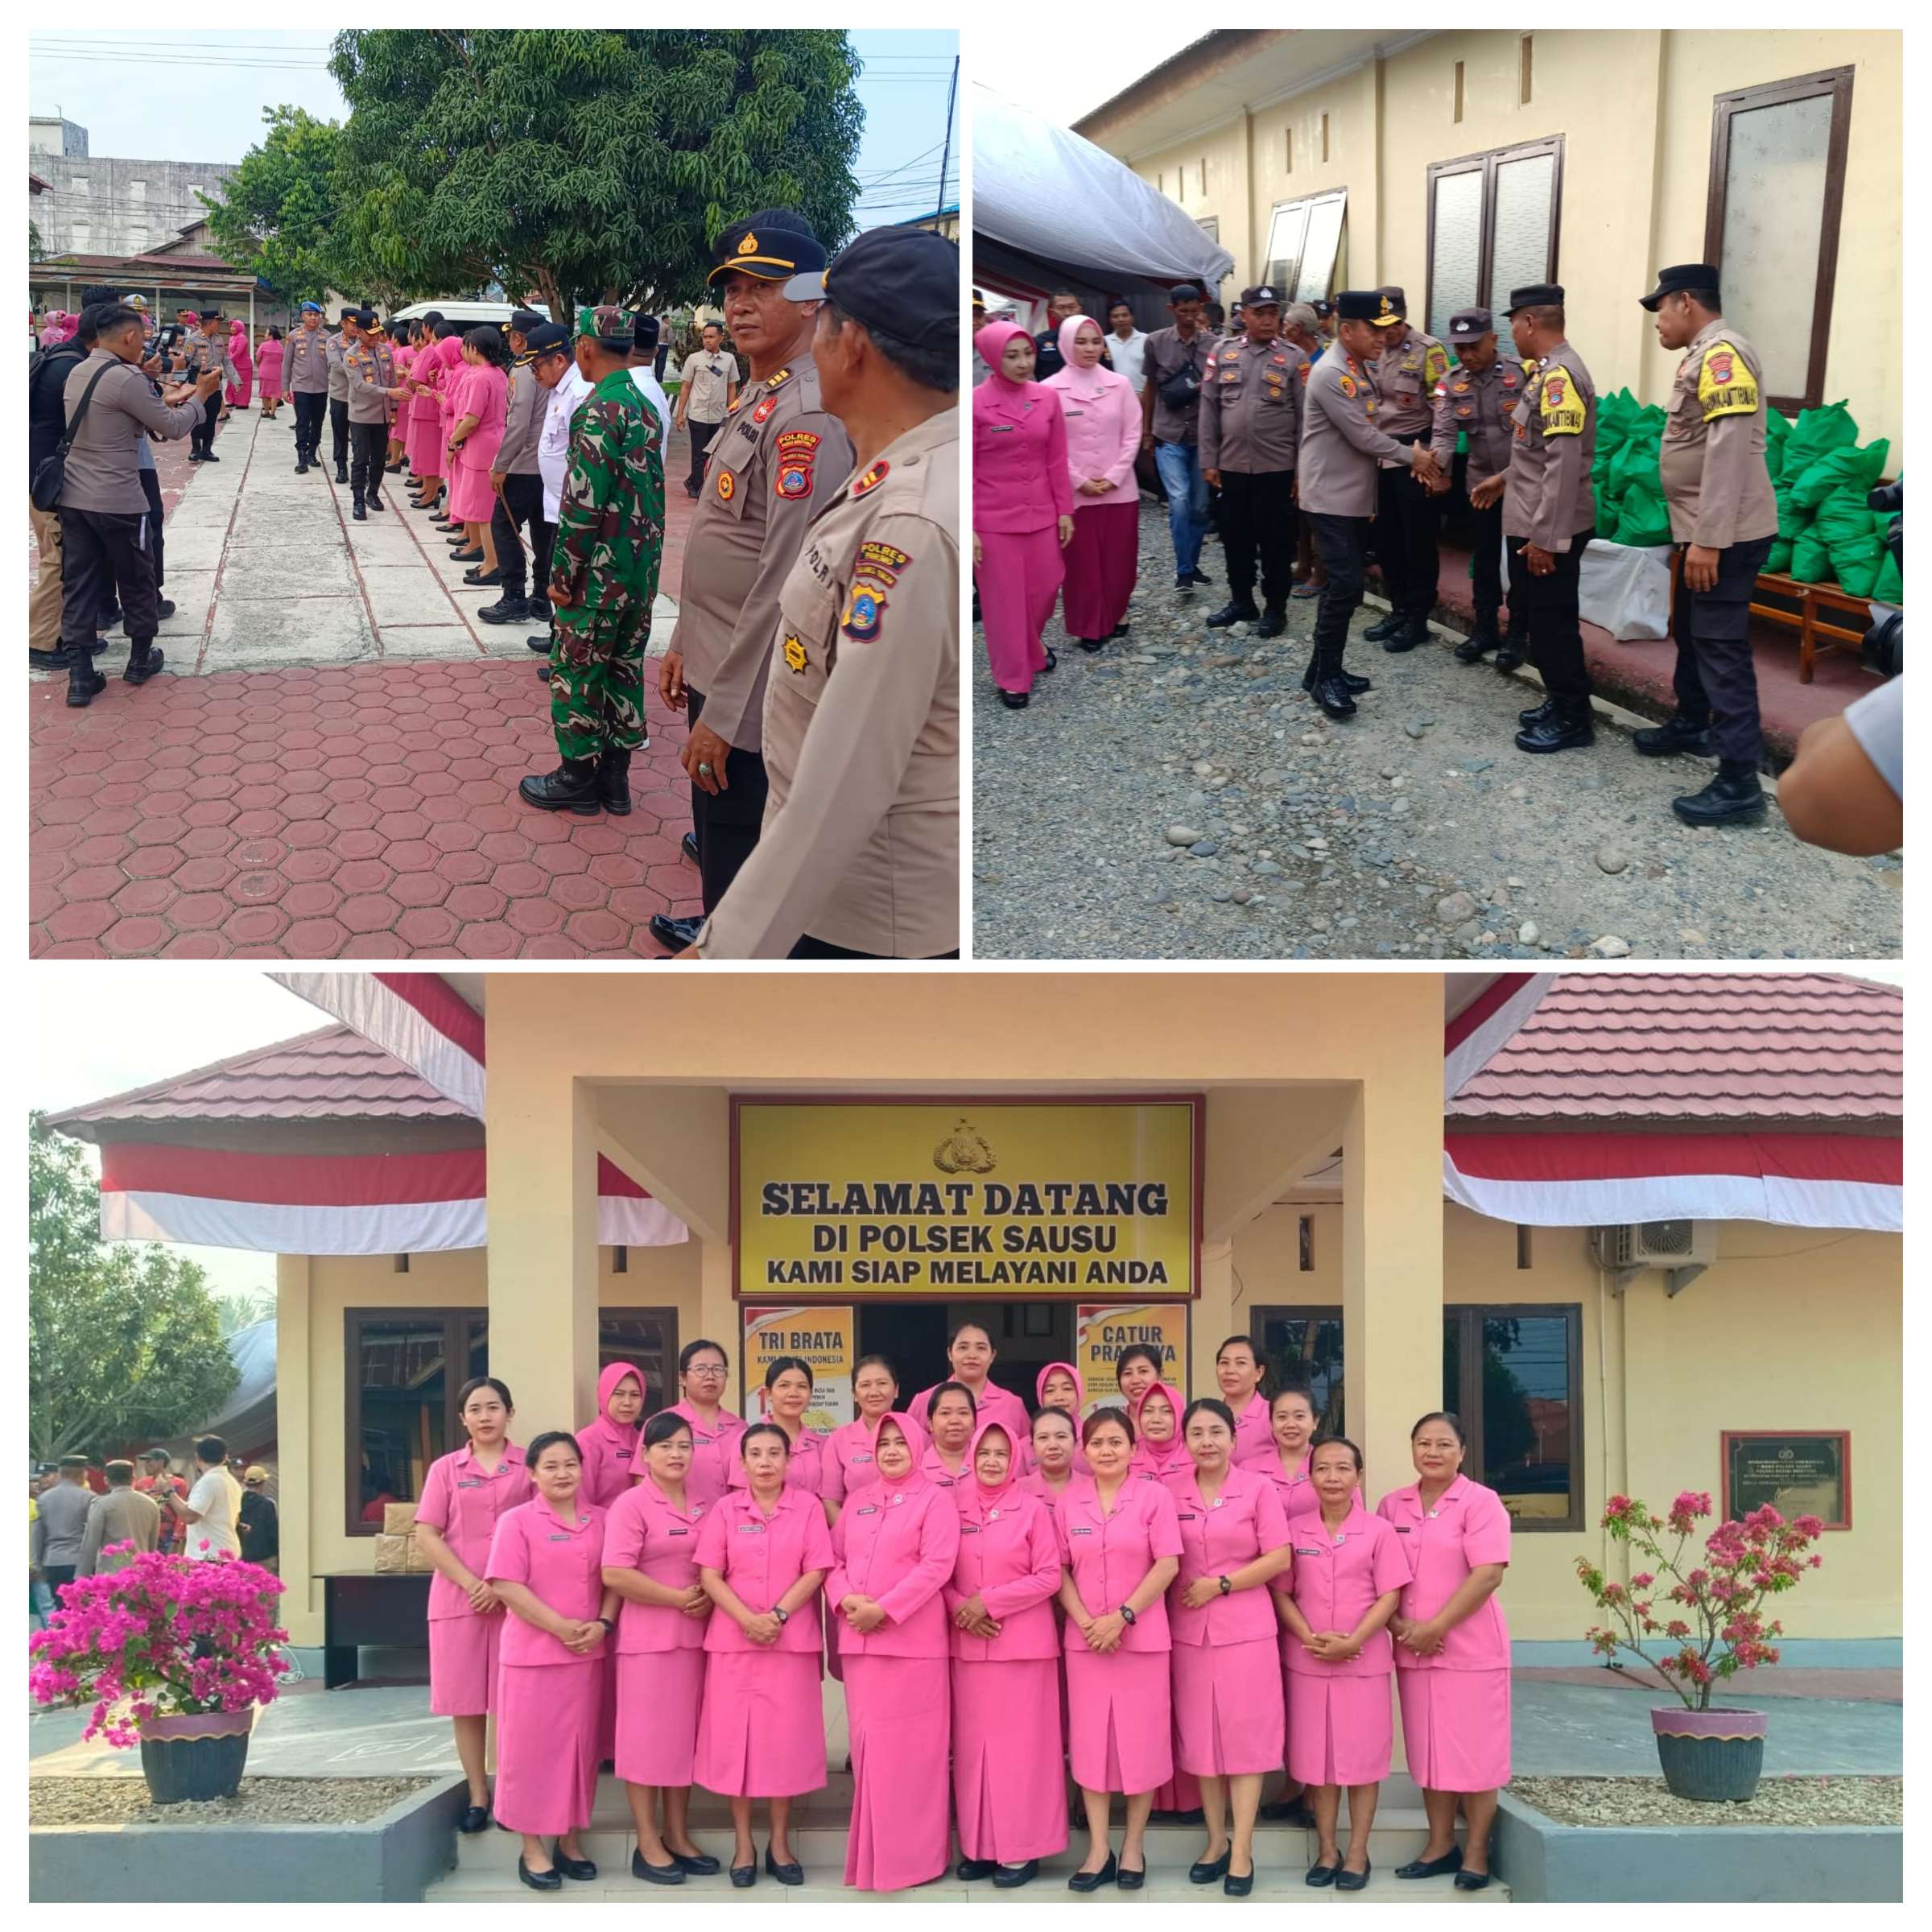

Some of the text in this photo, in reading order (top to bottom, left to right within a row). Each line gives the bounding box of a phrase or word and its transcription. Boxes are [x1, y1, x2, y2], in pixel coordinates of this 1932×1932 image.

[737, 420, 759, 444] POLRI
[778, 433, 817, 444] POLRES
[861, 543, 907, 564] POLRES
[762, 1183, 1169, 1216] SELAMAT DATANG
[814, 1224, 1117, 1253] DI POLSEK SAUSU
[767, 1261, 1168, 1285] KAMI SIAP MELAYANI ANDA
[759, 1331, 844, 1350] TRI BRATA
[1103, 1326, 1162, 1342] CATUR
[805, 1355, 844, 1364] INDONESIA
[1091, 1344, 1175, 1361] PRAYA
